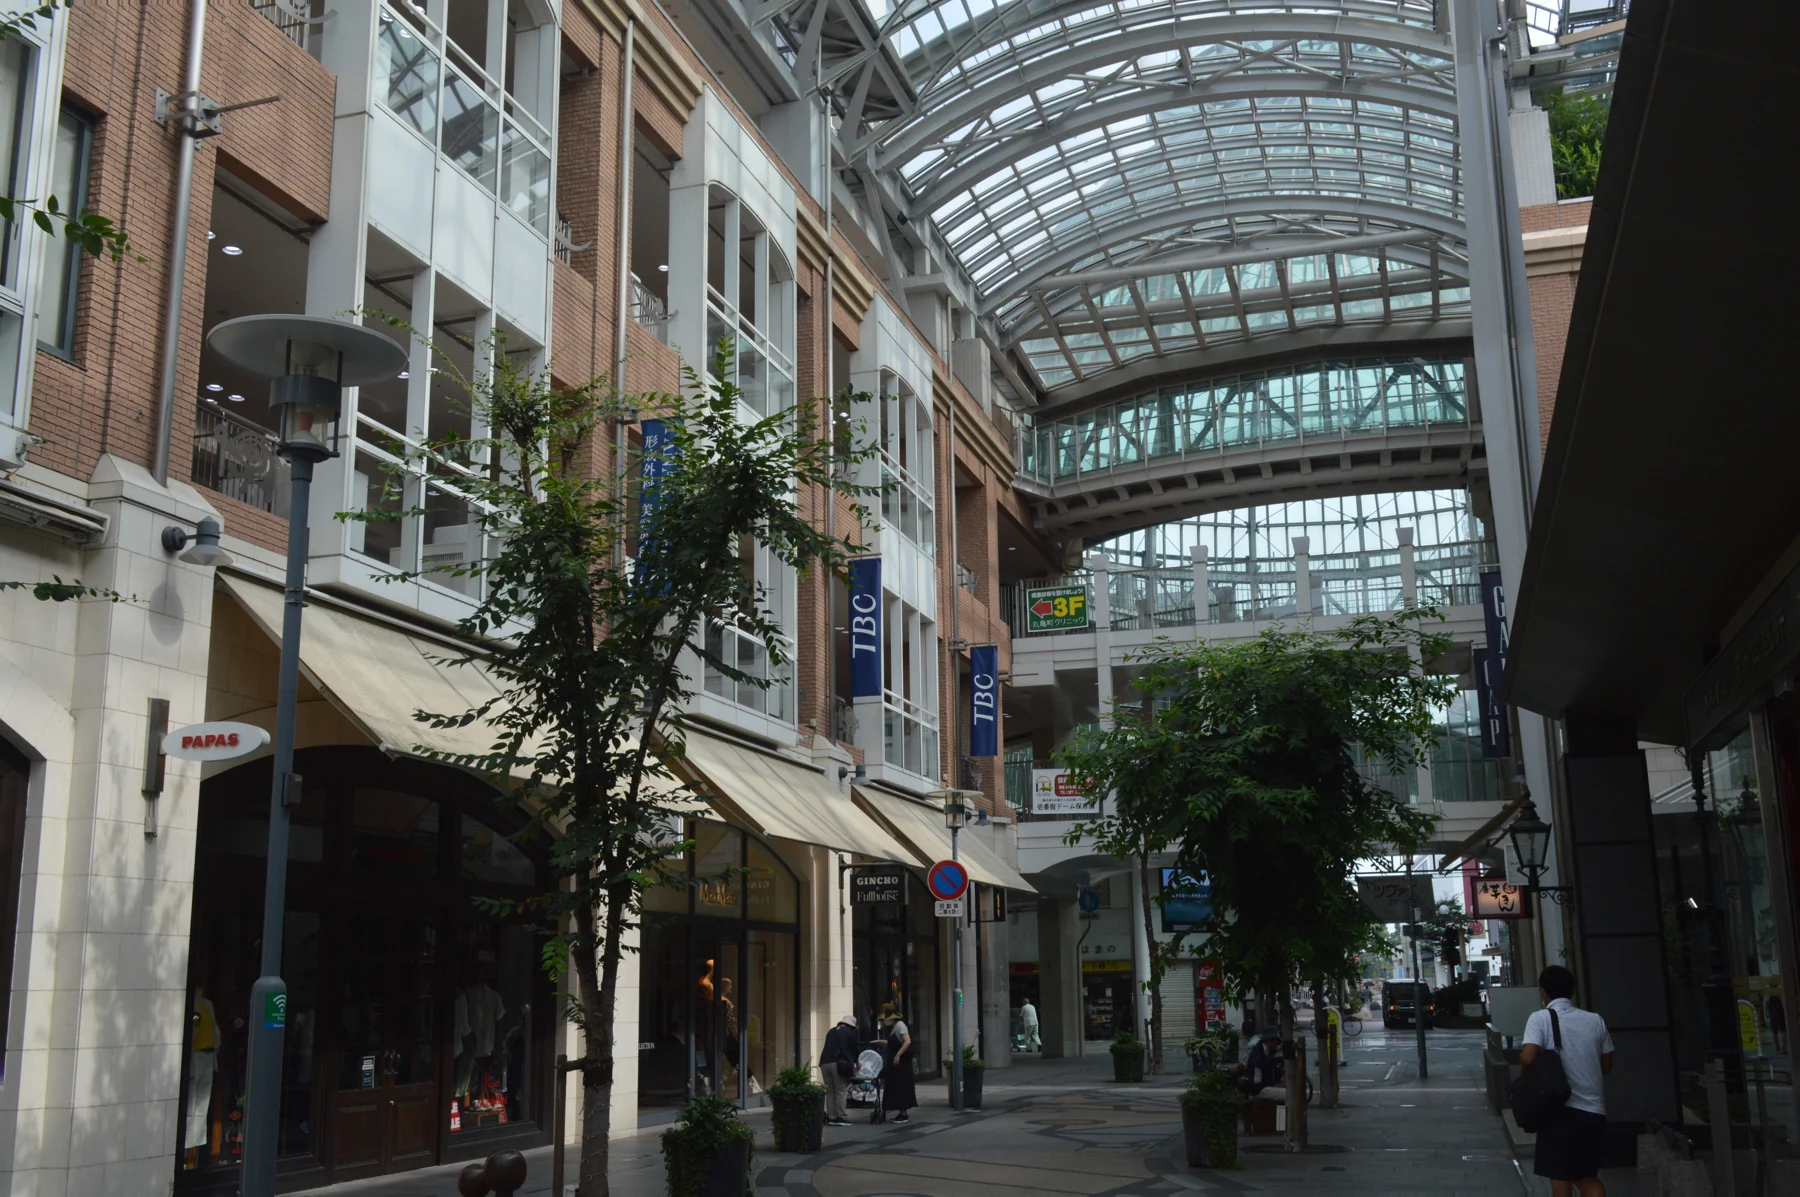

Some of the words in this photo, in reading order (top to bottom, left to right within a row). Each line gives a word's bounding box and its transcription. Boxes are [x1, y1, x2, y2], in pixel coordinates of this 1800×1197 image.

[1053, 595, 1085, 618] 3F
[852, 593, 877, 659] TBC
[1032, 616, 1085, 628] 丸亀町クリニック
[973, 673, 994, 726] TBC
[182, 733, 239, 749] PAPAS
[856, 876, 899, 886] GINCHO
[1081, 944, 1116, 954] はまの
